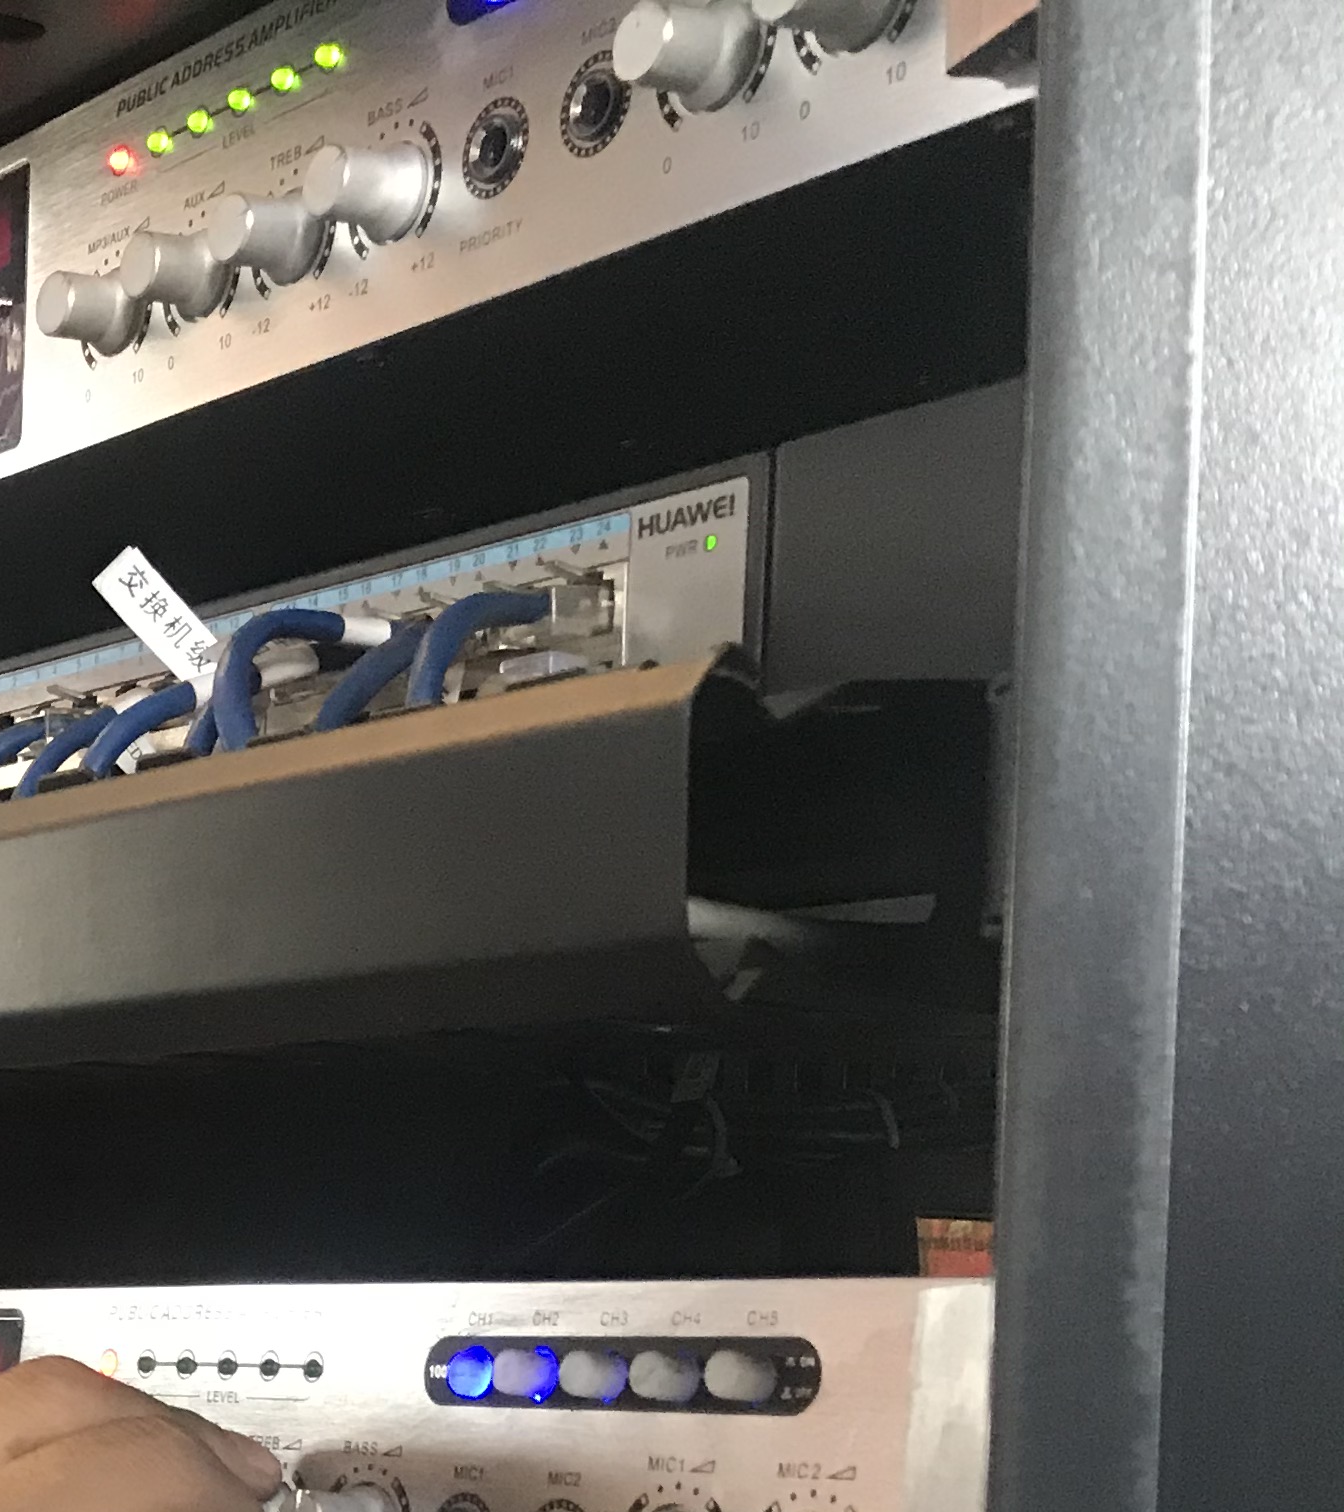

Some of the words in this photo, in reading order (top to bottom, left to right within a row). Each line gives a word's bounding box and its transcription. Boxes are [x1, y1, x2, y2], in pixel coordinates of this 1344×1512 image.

[116, 75, 168, 117] PUBLIC
[171, 36, 246, 90] ADDRESS
[885, 61, 908, 86] 10
[367, 98, 404, 127] BASS
[799, 100, 811, 120] 0
[222, 124, 255, 149] LEVEL
[741, 120, 761, 143] 10
[270, 145, 302, 171] TREB
[662, 155, 673, 175] 0
[100, 180, 138, 206] POWER
[183, 191, 205, 211] AUX
[459, 218, 524, 254] PRIORITY
[412, 253, 435, 272] +12
[309, 294, 331, 312] +12
[219, 333, 232, 351] 10
[132, 367, 145, 384] 10
[637, 492, 736, 539] HUAWEI
[472, 553, 486, 568] 20
[533, 537, 548, 552] 22
[569, 527, 584, 543] 23
[597, 520, 612, 536] 24
[468, 1311, 494, 1327] CH1
[532, 1311, 560, 1327] CH2
[600, 1311, 629, 1327] CH3
[671, 1310, 701, 1326] CH4
[747, 1310, 779, 1326] CH5
[206, 1390, 240, 1404] LEVEL
[343, 1440, 379, 1456] BASS
[453, 1465, 485, 1481] MIC1
[647, 1456, 685, 1475] MIC1
[547, 1471, 582, 1487] MIC2
